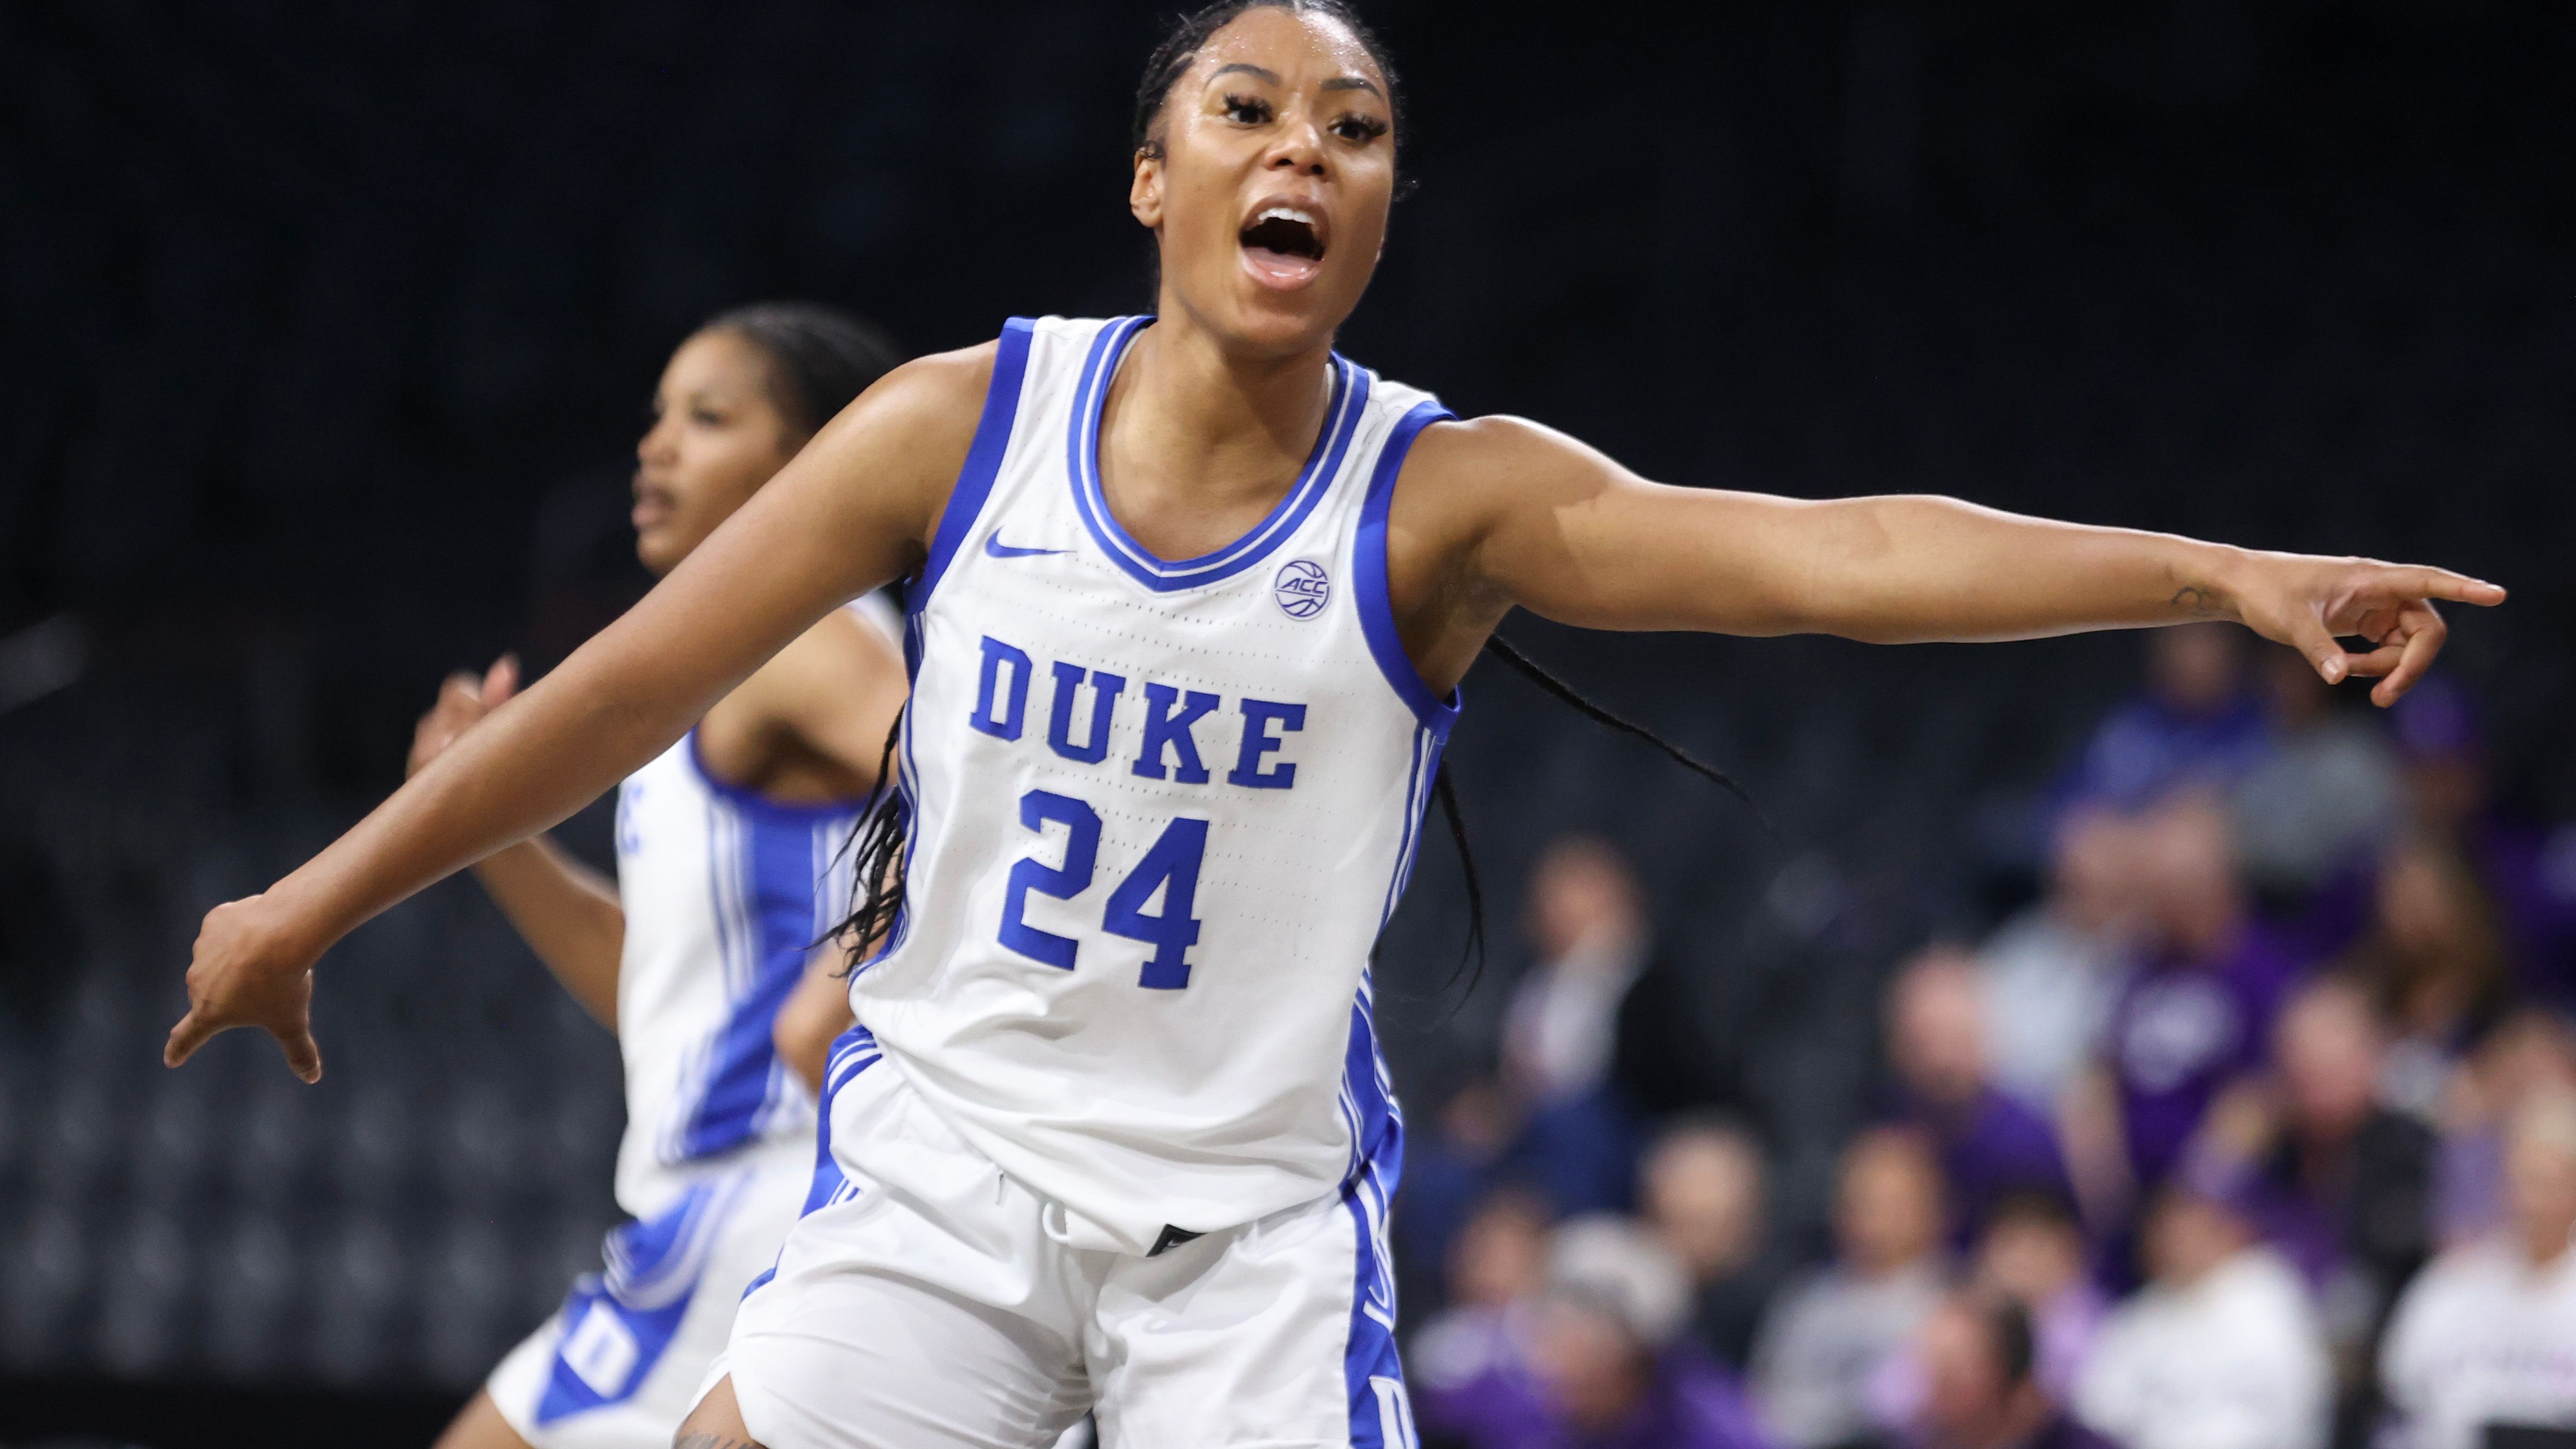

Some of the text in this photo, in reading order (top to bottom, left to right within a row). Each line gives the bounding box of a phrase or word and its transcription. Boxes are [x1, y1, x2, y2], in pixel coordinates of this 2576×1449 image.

[1280, 577, 1329, 595] ACC
[969, 635, 1307, 790] DUKE
[997, 789, 1209, 990] 24
[560, 1297, 641, 1399] D
